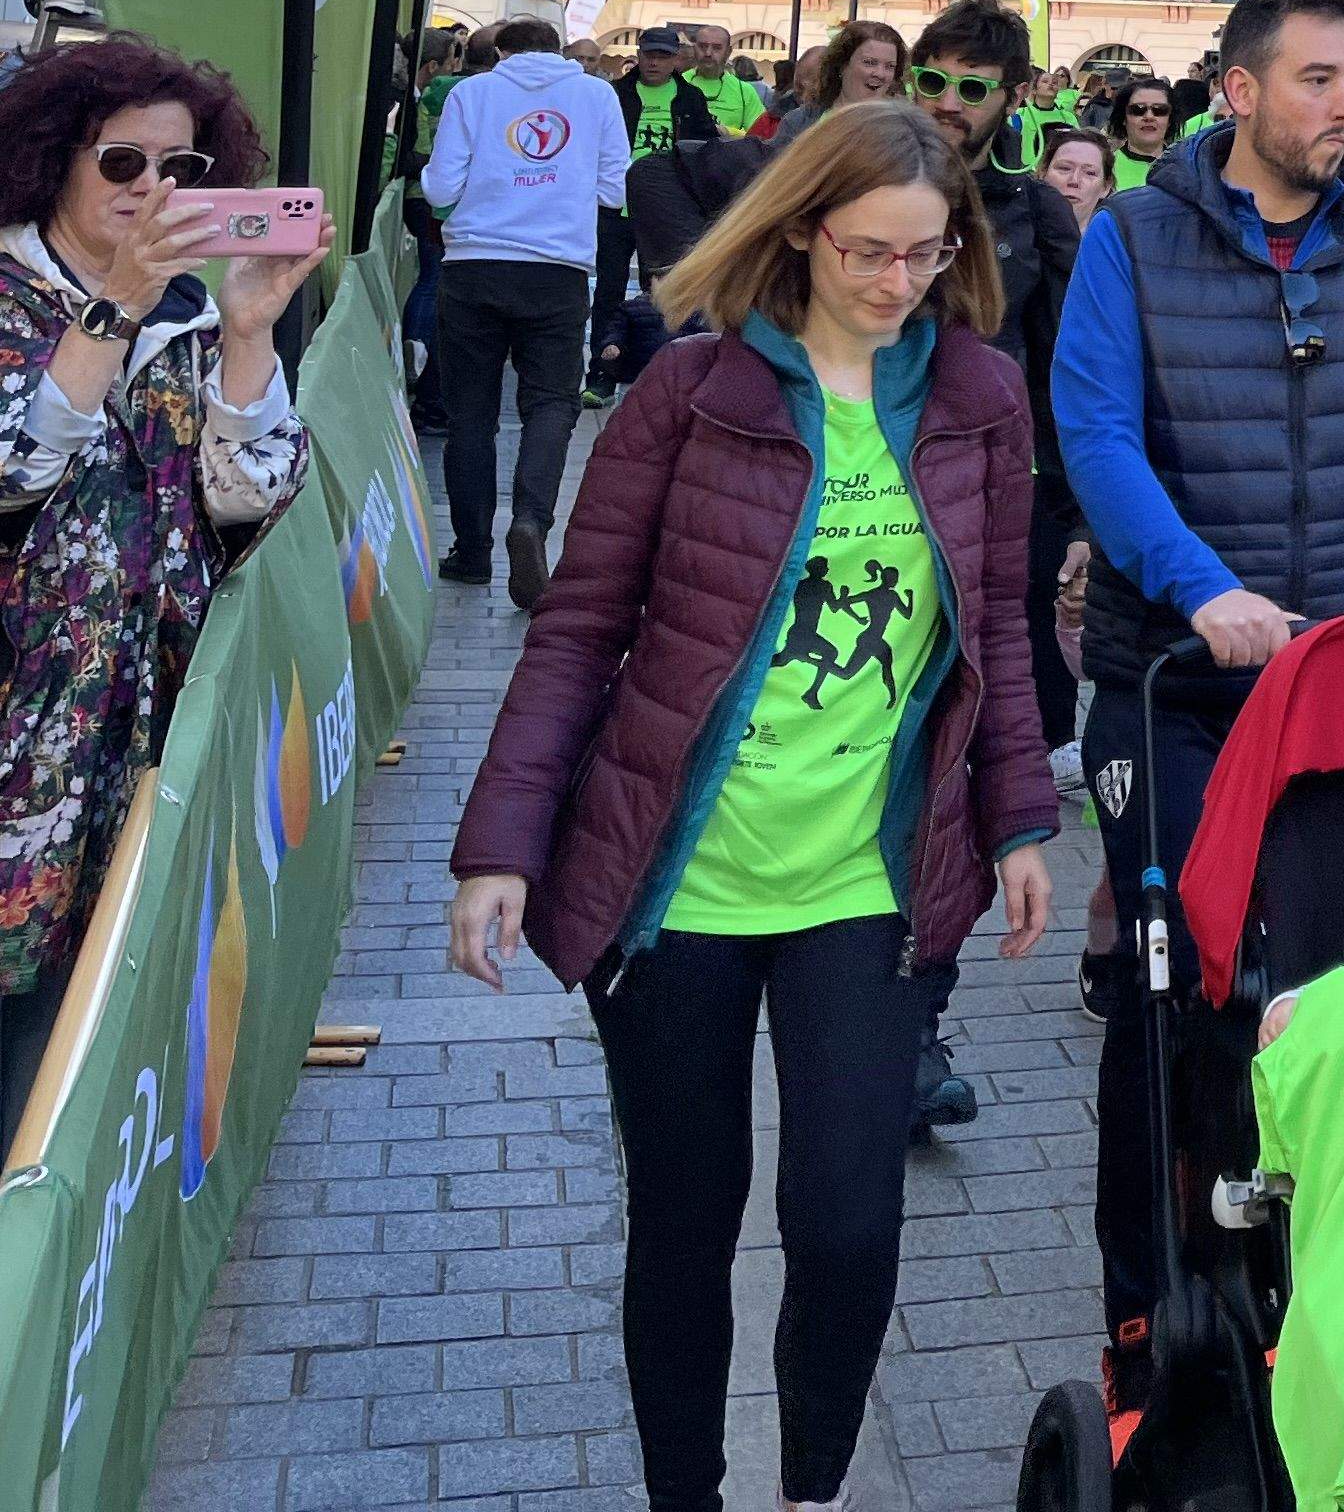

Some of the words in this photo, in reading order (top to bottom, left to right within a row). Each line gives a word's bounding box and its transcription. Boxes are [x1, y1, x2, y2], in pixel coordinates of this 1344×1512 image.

[814, 526, 850, 539] POR
[855, 524, 877, 536] LA
[882, 522, 924, 536] IGUA
